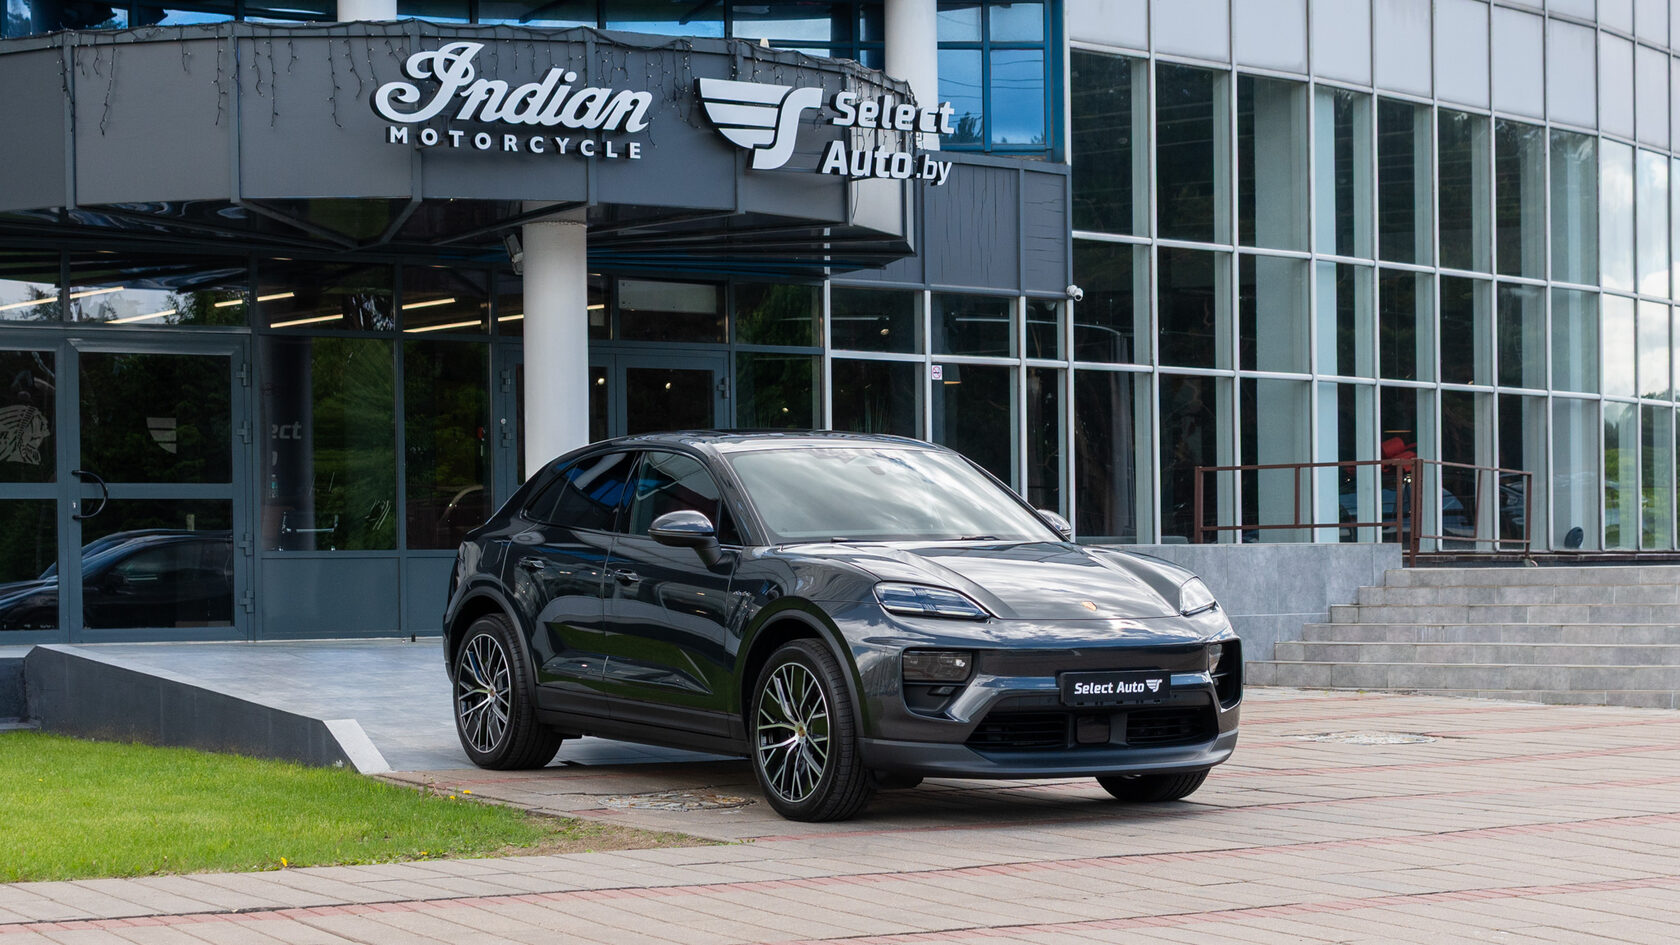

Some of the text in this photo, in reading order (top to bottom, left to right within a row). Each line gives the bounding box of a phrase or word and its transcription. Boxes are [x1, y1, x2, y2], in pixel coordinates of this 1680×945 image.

[375, 41, 652, 133] Indian
[832, 91, 955, 134] Select
[388, 126, 641, 159] MOTORCYCLE
[822, 140, 952, 186] Auto.by
[1074, 681, 1145, 694] Select Auto
